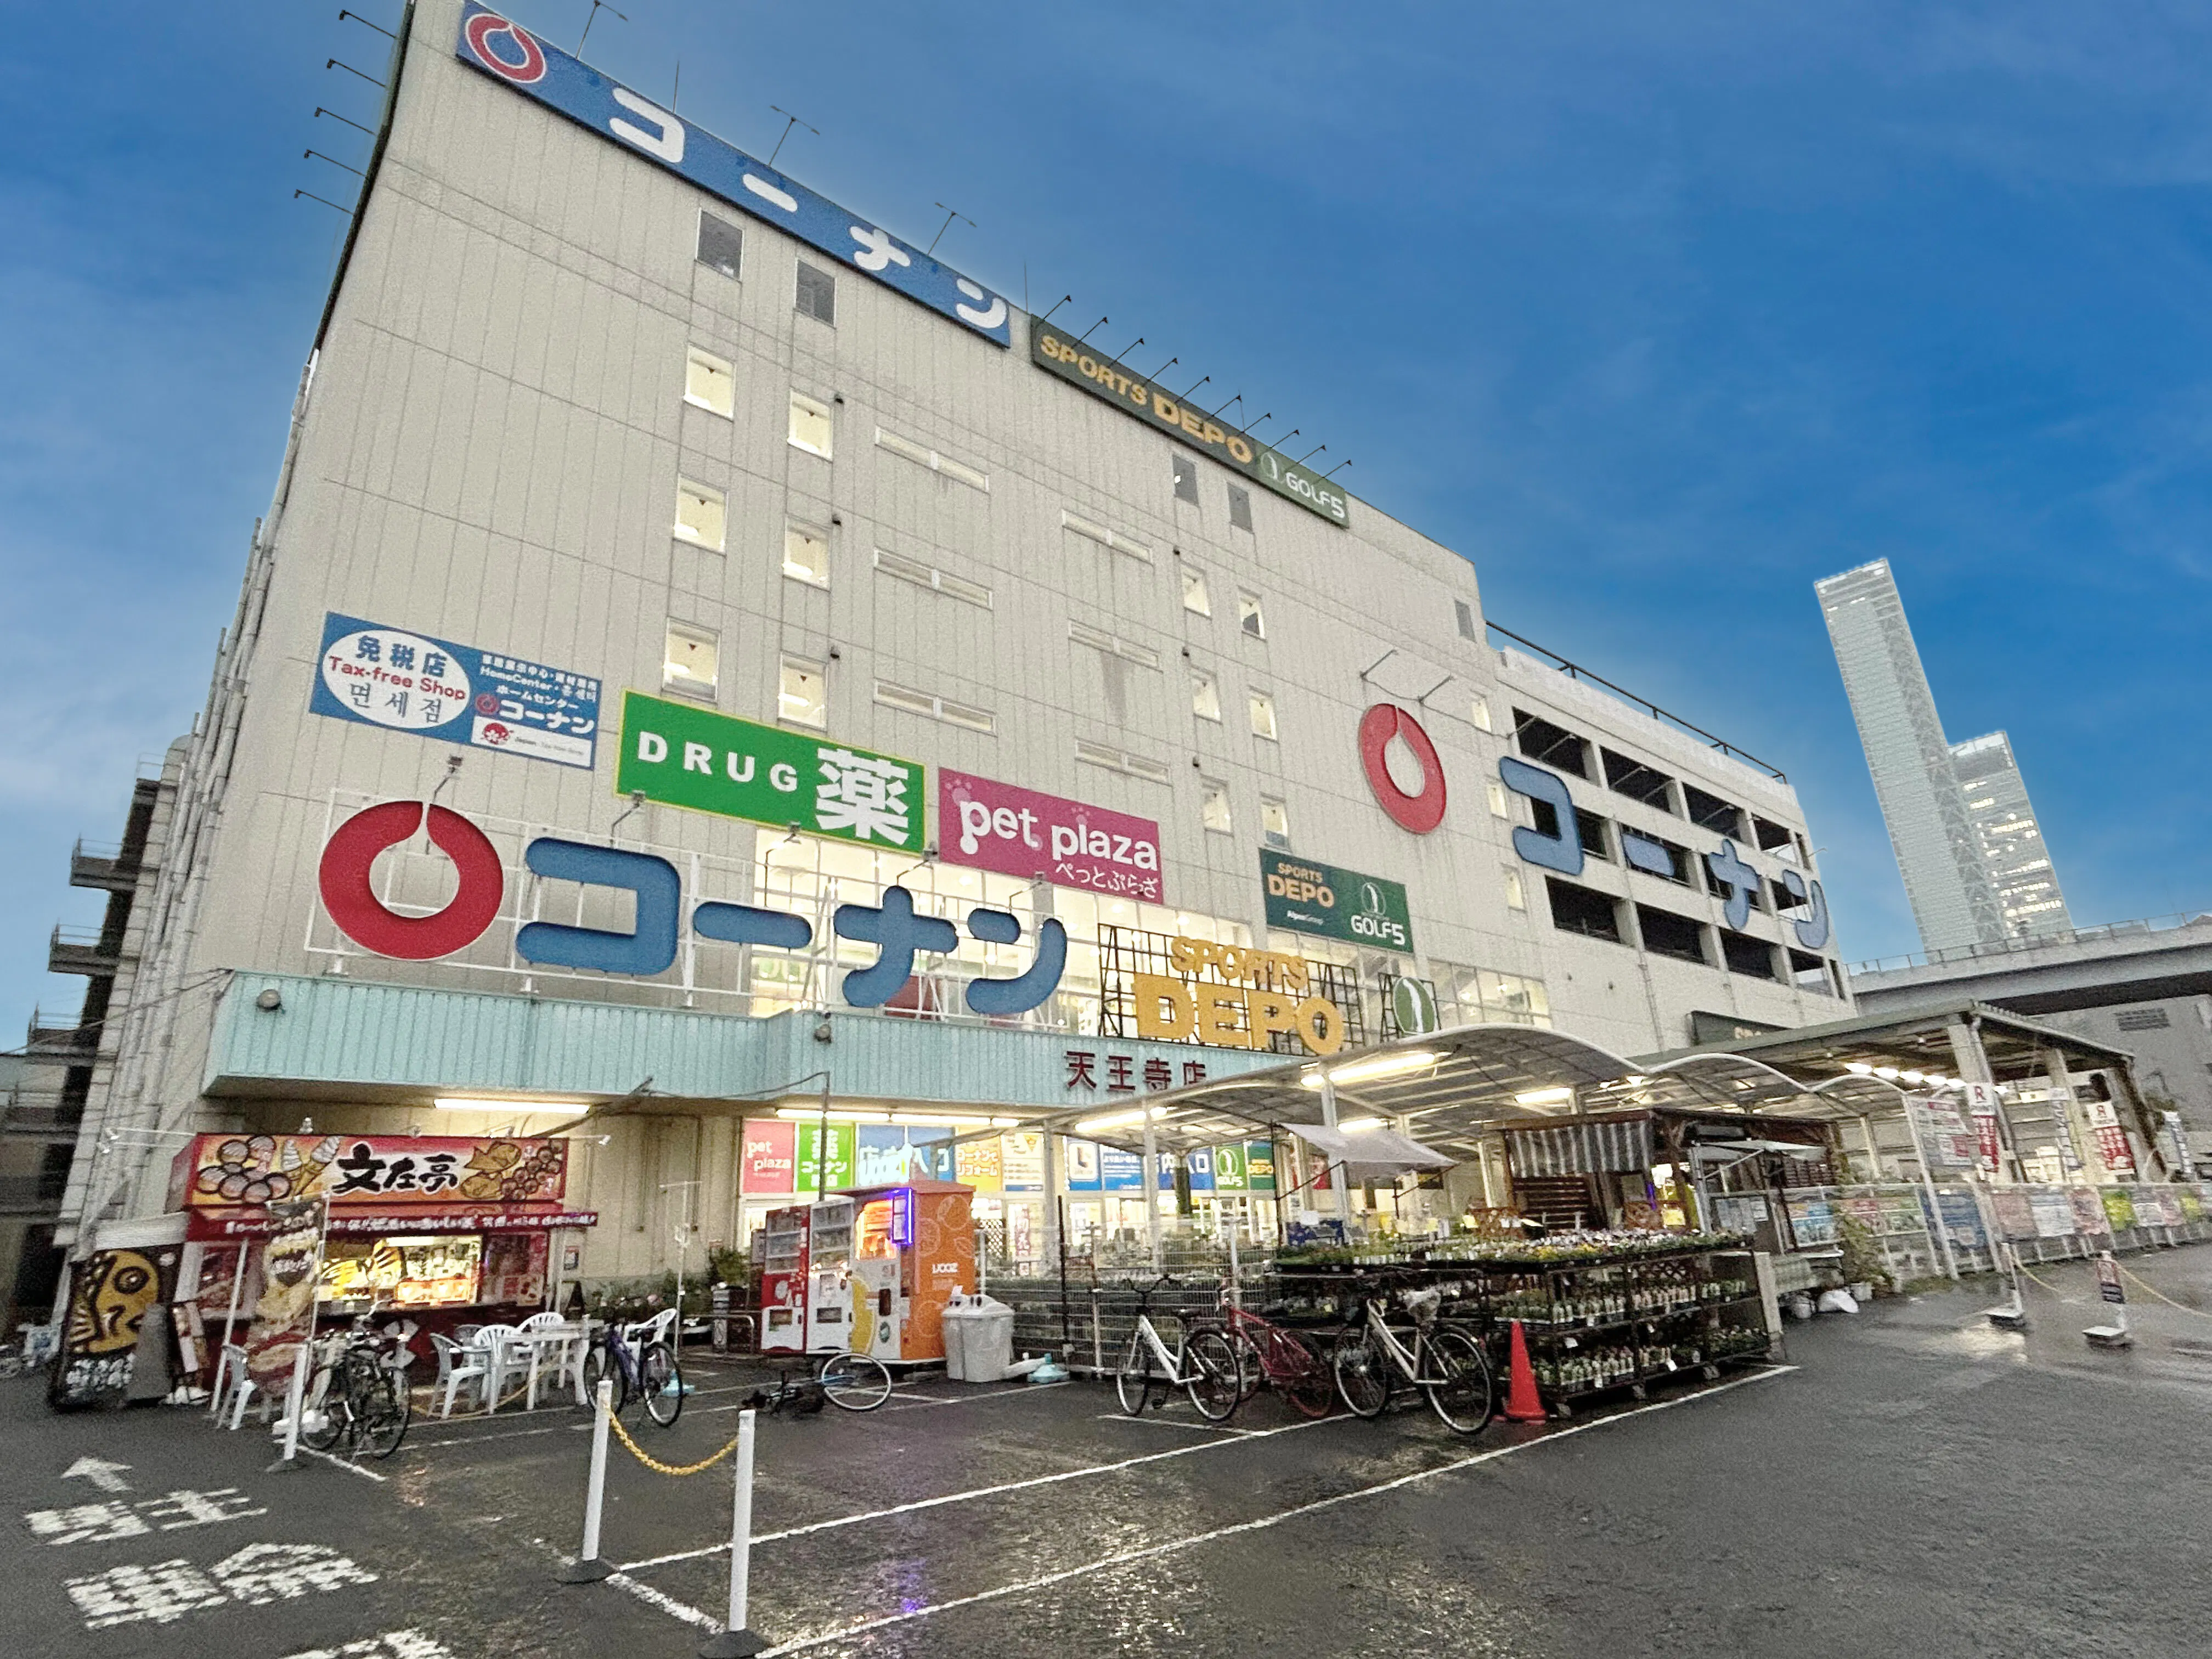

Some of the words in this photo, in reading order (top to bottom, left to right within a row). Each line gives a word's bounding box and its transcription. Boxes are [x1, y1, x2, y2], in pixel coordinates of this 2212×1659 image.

[610, 88, 1006, 328] コーナン
[1040, 335, 1147, 405] SPORTS
[1153, 393, 1252, 464] DEPO
[329, 656, 413, 688] Tax-free
[420, 678, 466, 701] Shop
[356, 635, 447, 678] 免税店
[350, 682, 442, 723] 면세점
[499, 699, 594, 734] コーナン
[637, 730, 798, 793] DRUG
[815, 747, 910, 847] 薬
[960, 800, 1039, 855] pet
[1050, 823, 1158, 871] plaza
[1499, 756, 1829, 949] コーナン
[1267, 873, 1335, 908] DEPO
[1278, 862, 1323, 883] SPORTS
[515, 837, 1066, 1015] コーナン
[1351, 915, 1406, 945] GOLF5
[1170, 935, 1309, 990] SPORTS
[1132, 972, 1344, 1055] DEPO
[1065, 1050, 1206, 1091] 天王寺店
[747, 1141, 772, 1159] pet
[754, 1158, 792, 1172] plaza
